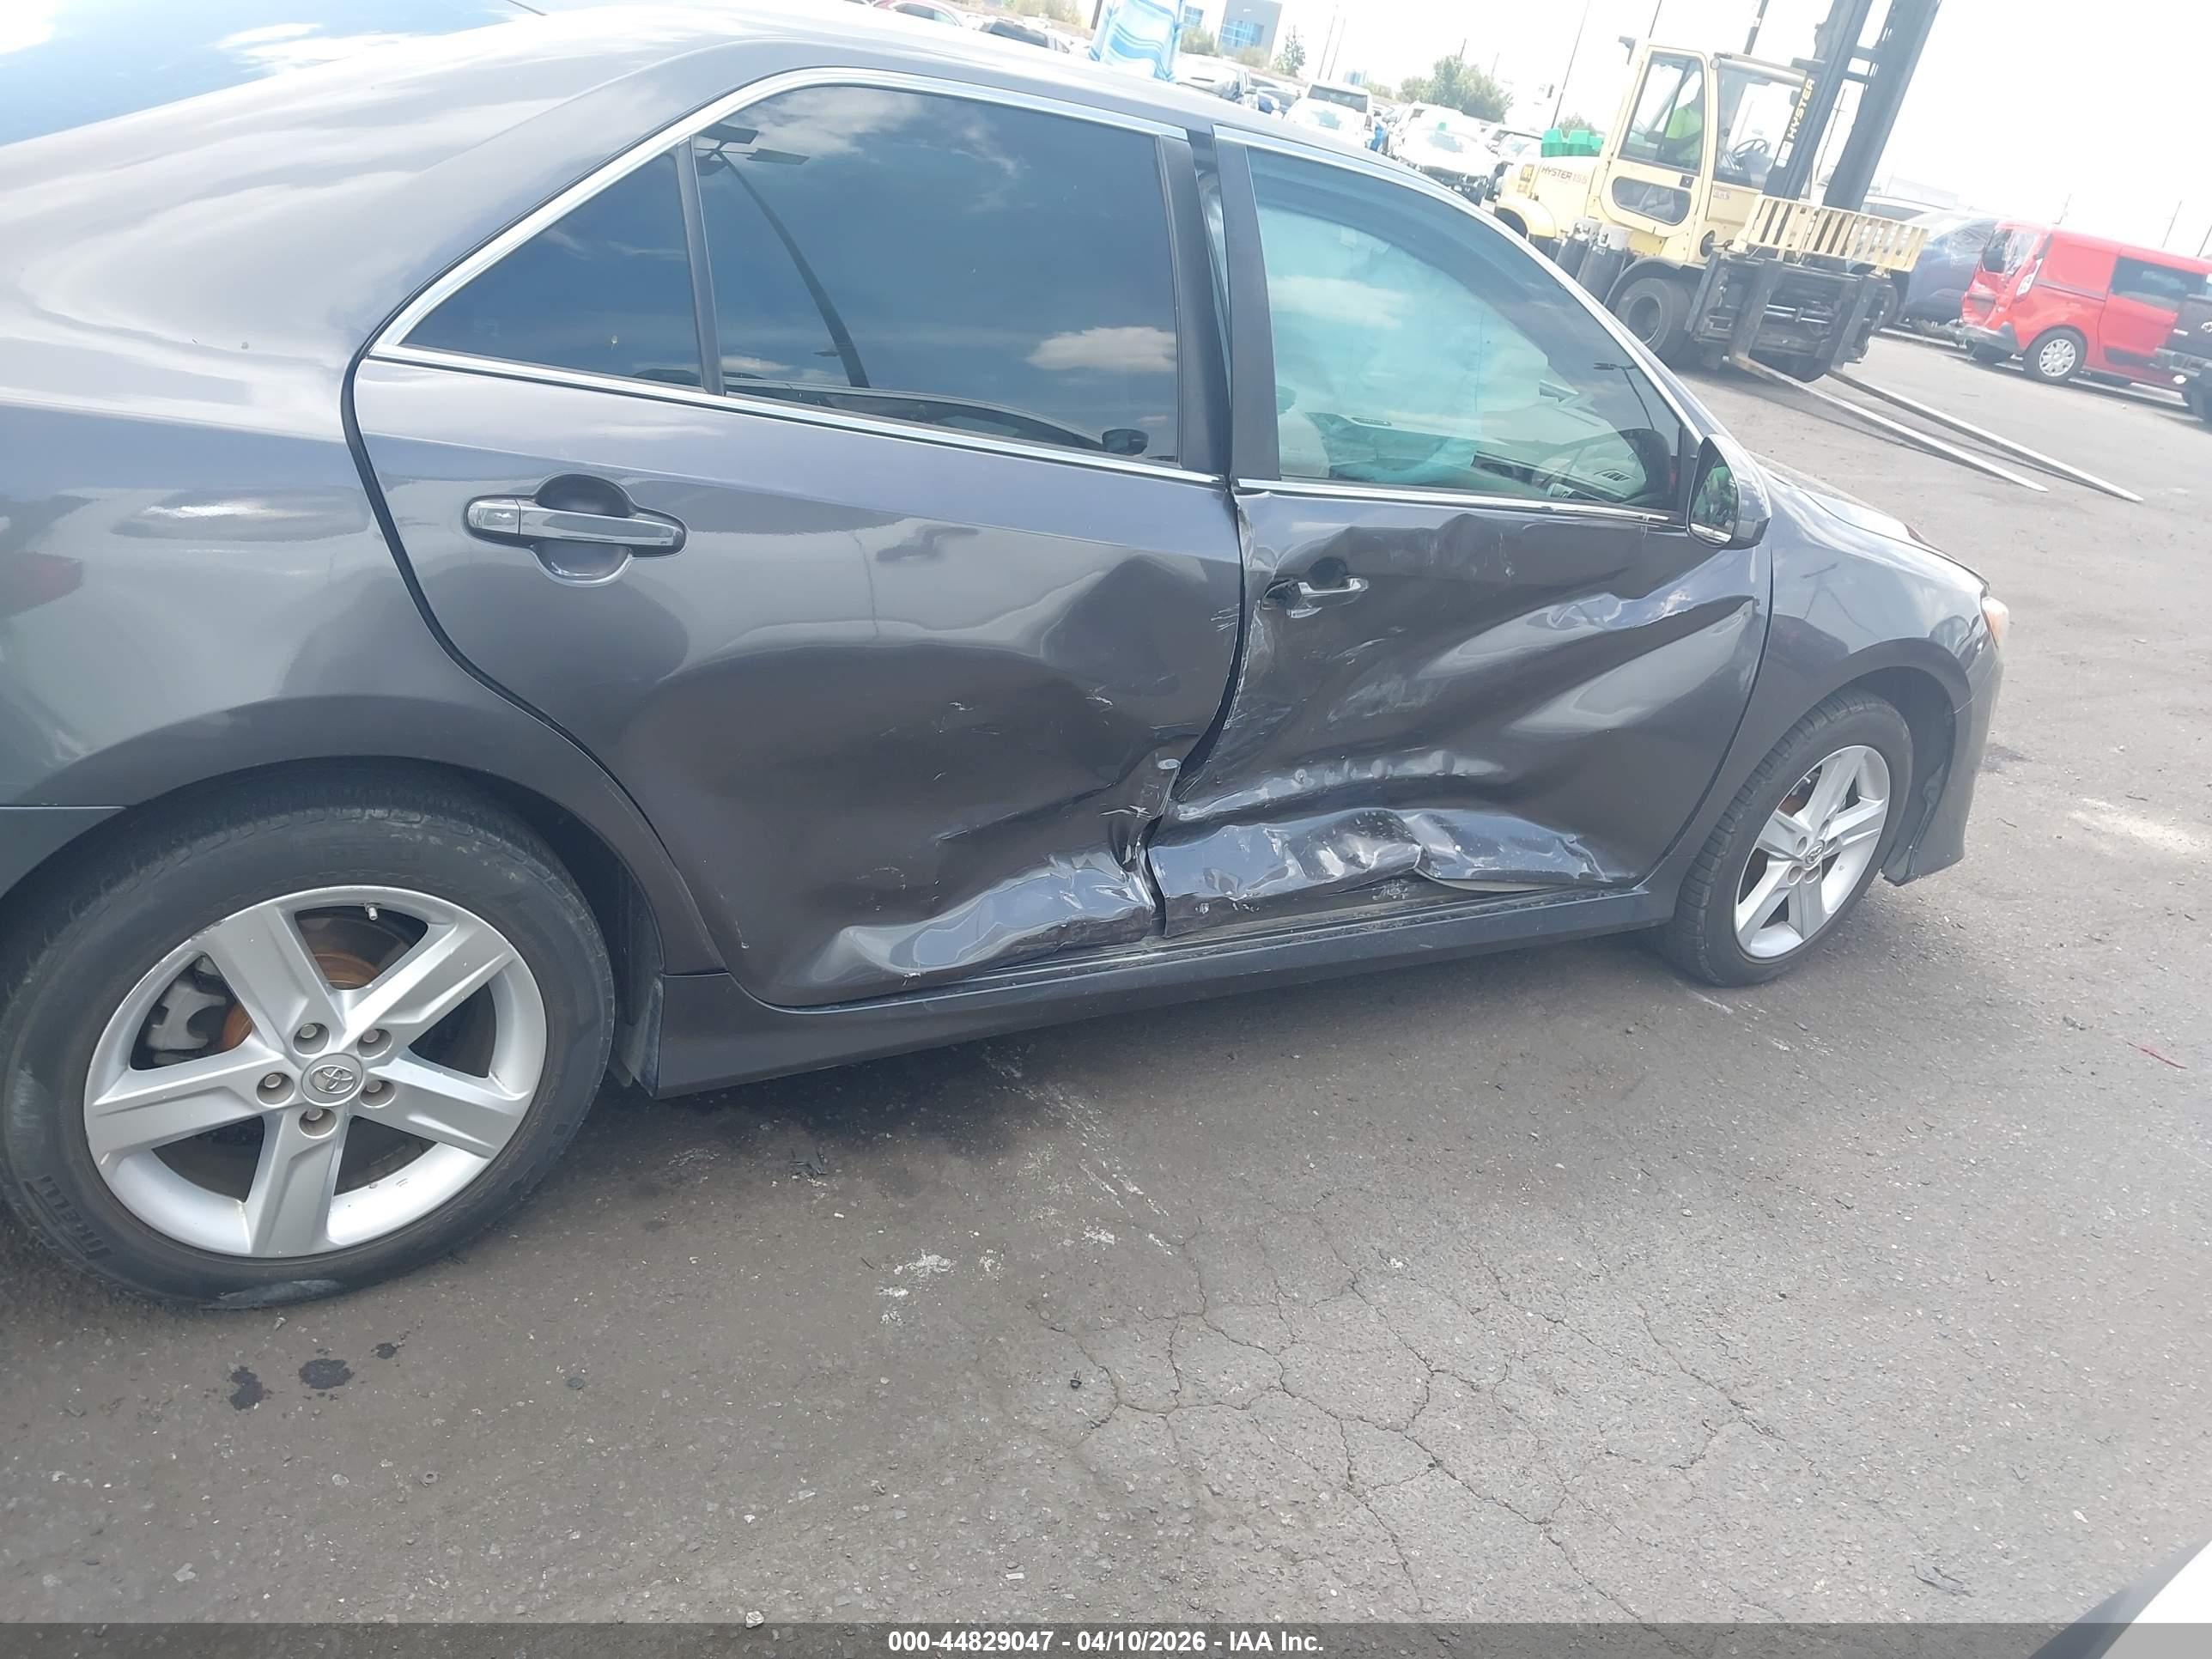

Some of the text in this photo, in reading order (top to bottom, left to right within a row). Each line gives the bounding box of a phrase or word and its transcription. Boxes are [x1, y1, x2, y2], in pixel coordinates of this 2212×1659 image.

[1785, 77, 1815, 140] HYSTER
[1540, 166, 1573, 179] HYSTER
[23, 1174, 112, 1261] PIRELLI
